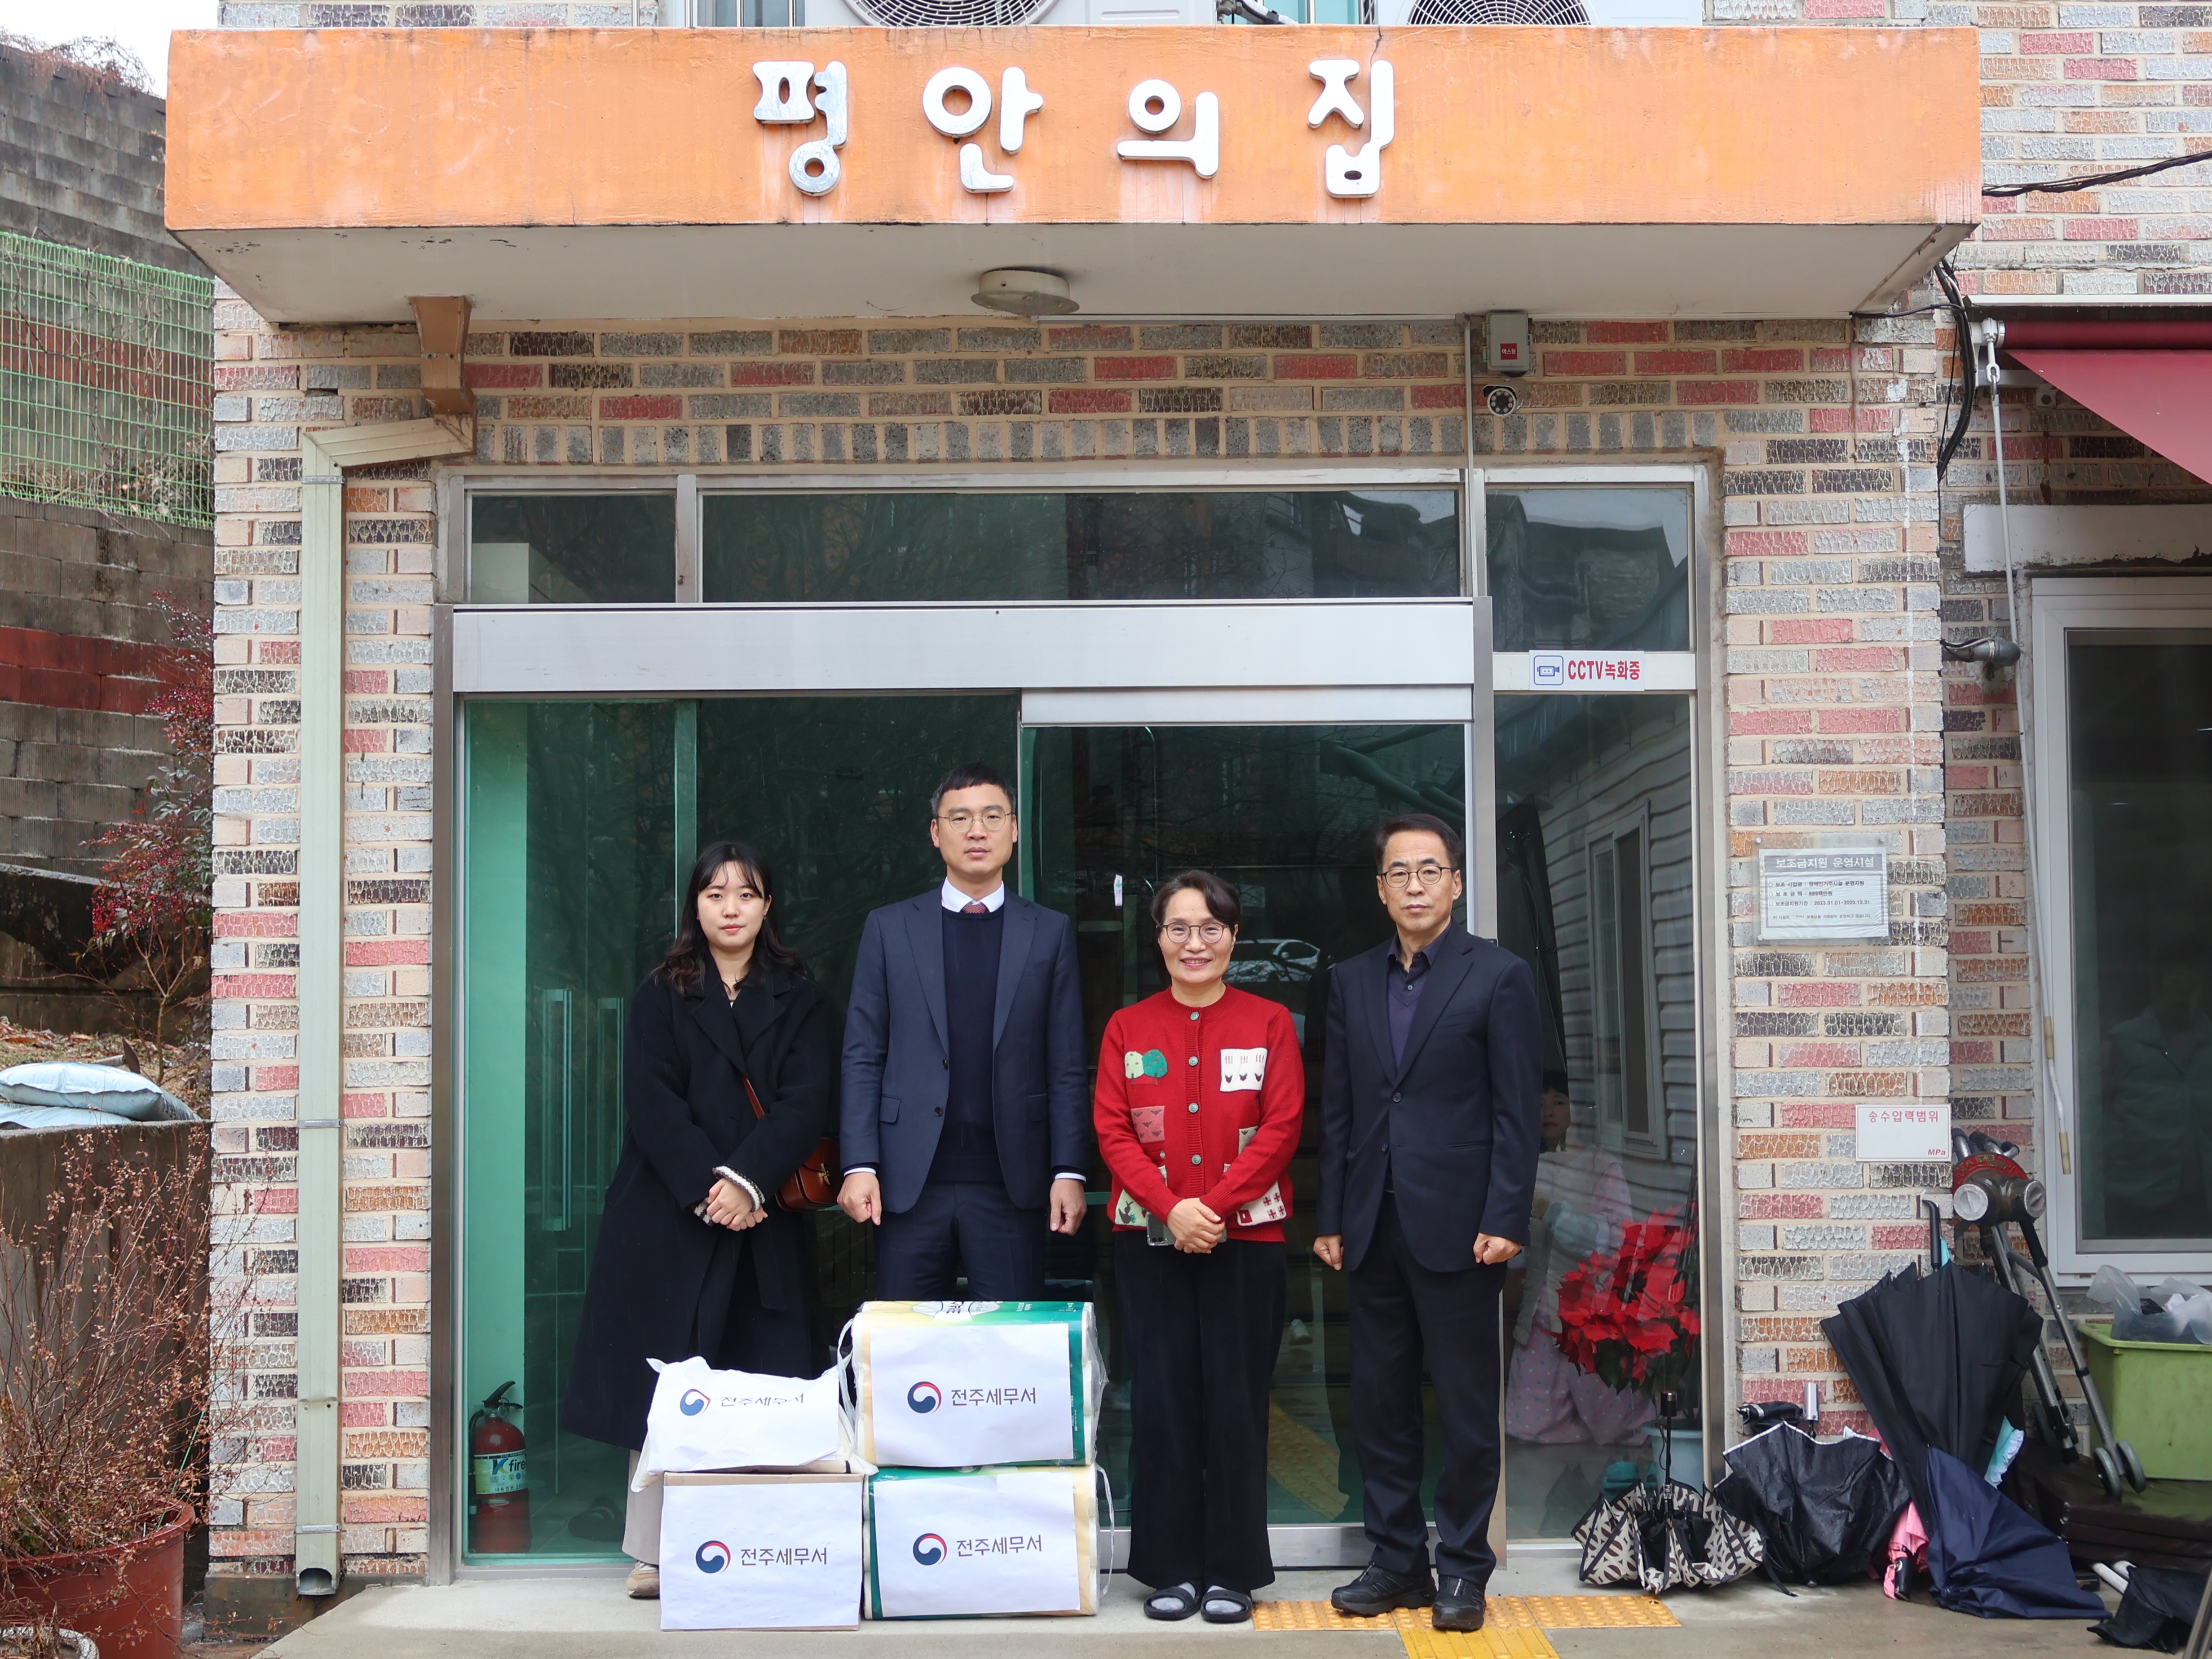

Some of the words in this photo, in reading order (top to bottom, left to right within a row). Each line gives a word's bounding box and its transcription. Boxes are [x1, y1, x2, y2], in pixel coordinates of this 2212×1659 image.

[1776, 857, 1827, 869] 보조금지원
[1833, 856, 1874, 868] 운영시설
[1868, 1111, 1938, 1123] 송수압력범위
[951, 1387, 1037, 1407] 전주세무서
[956, 1535, 1042, 1558] 전주세무서
[740, 1547, 827, 1566] 전주세무서
